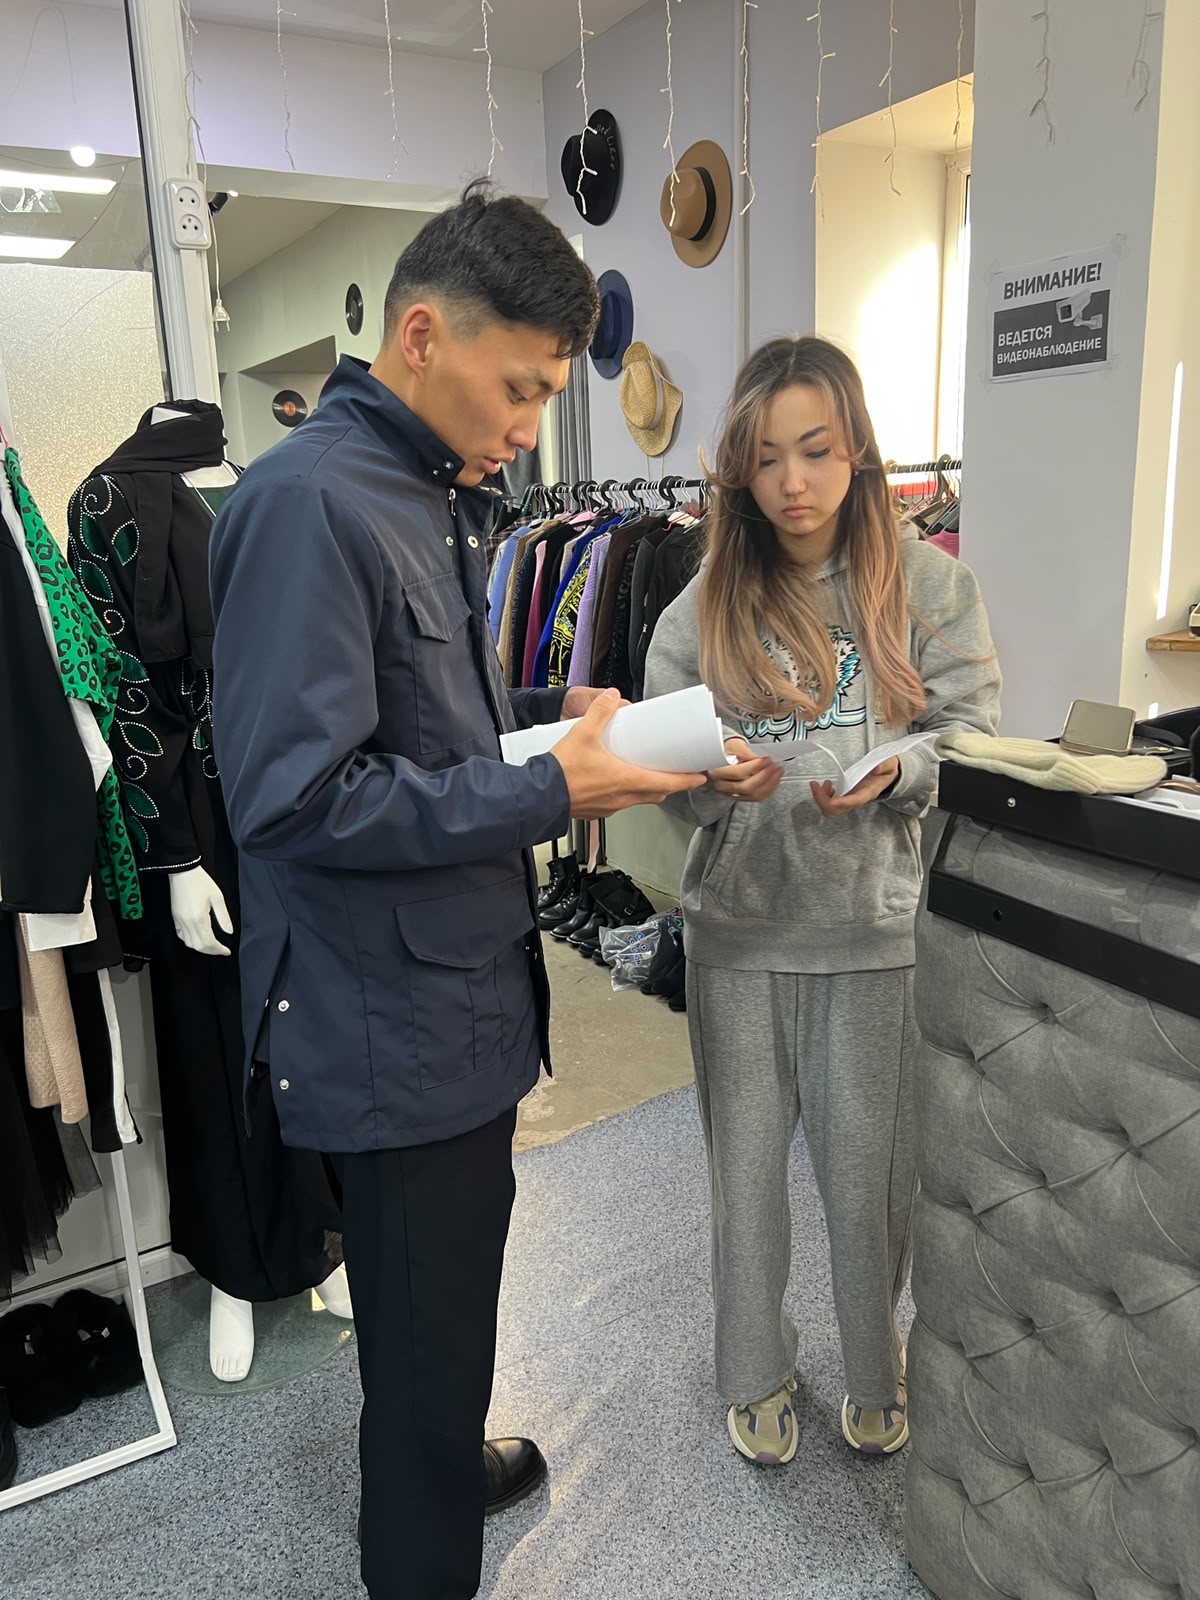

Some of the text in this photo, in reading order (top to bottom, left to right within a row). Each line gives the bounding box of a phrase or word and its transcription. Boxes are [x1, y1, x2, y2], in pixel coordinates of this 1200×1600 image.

[1003, 262, 1102, 299] ВНИМАНИЕ!
[998, 325, 1053, 347] ВЕДЕТСЯ
[997, 337, 1102, 364] ВИДЕОНАБЛЮДЕНИЕ
